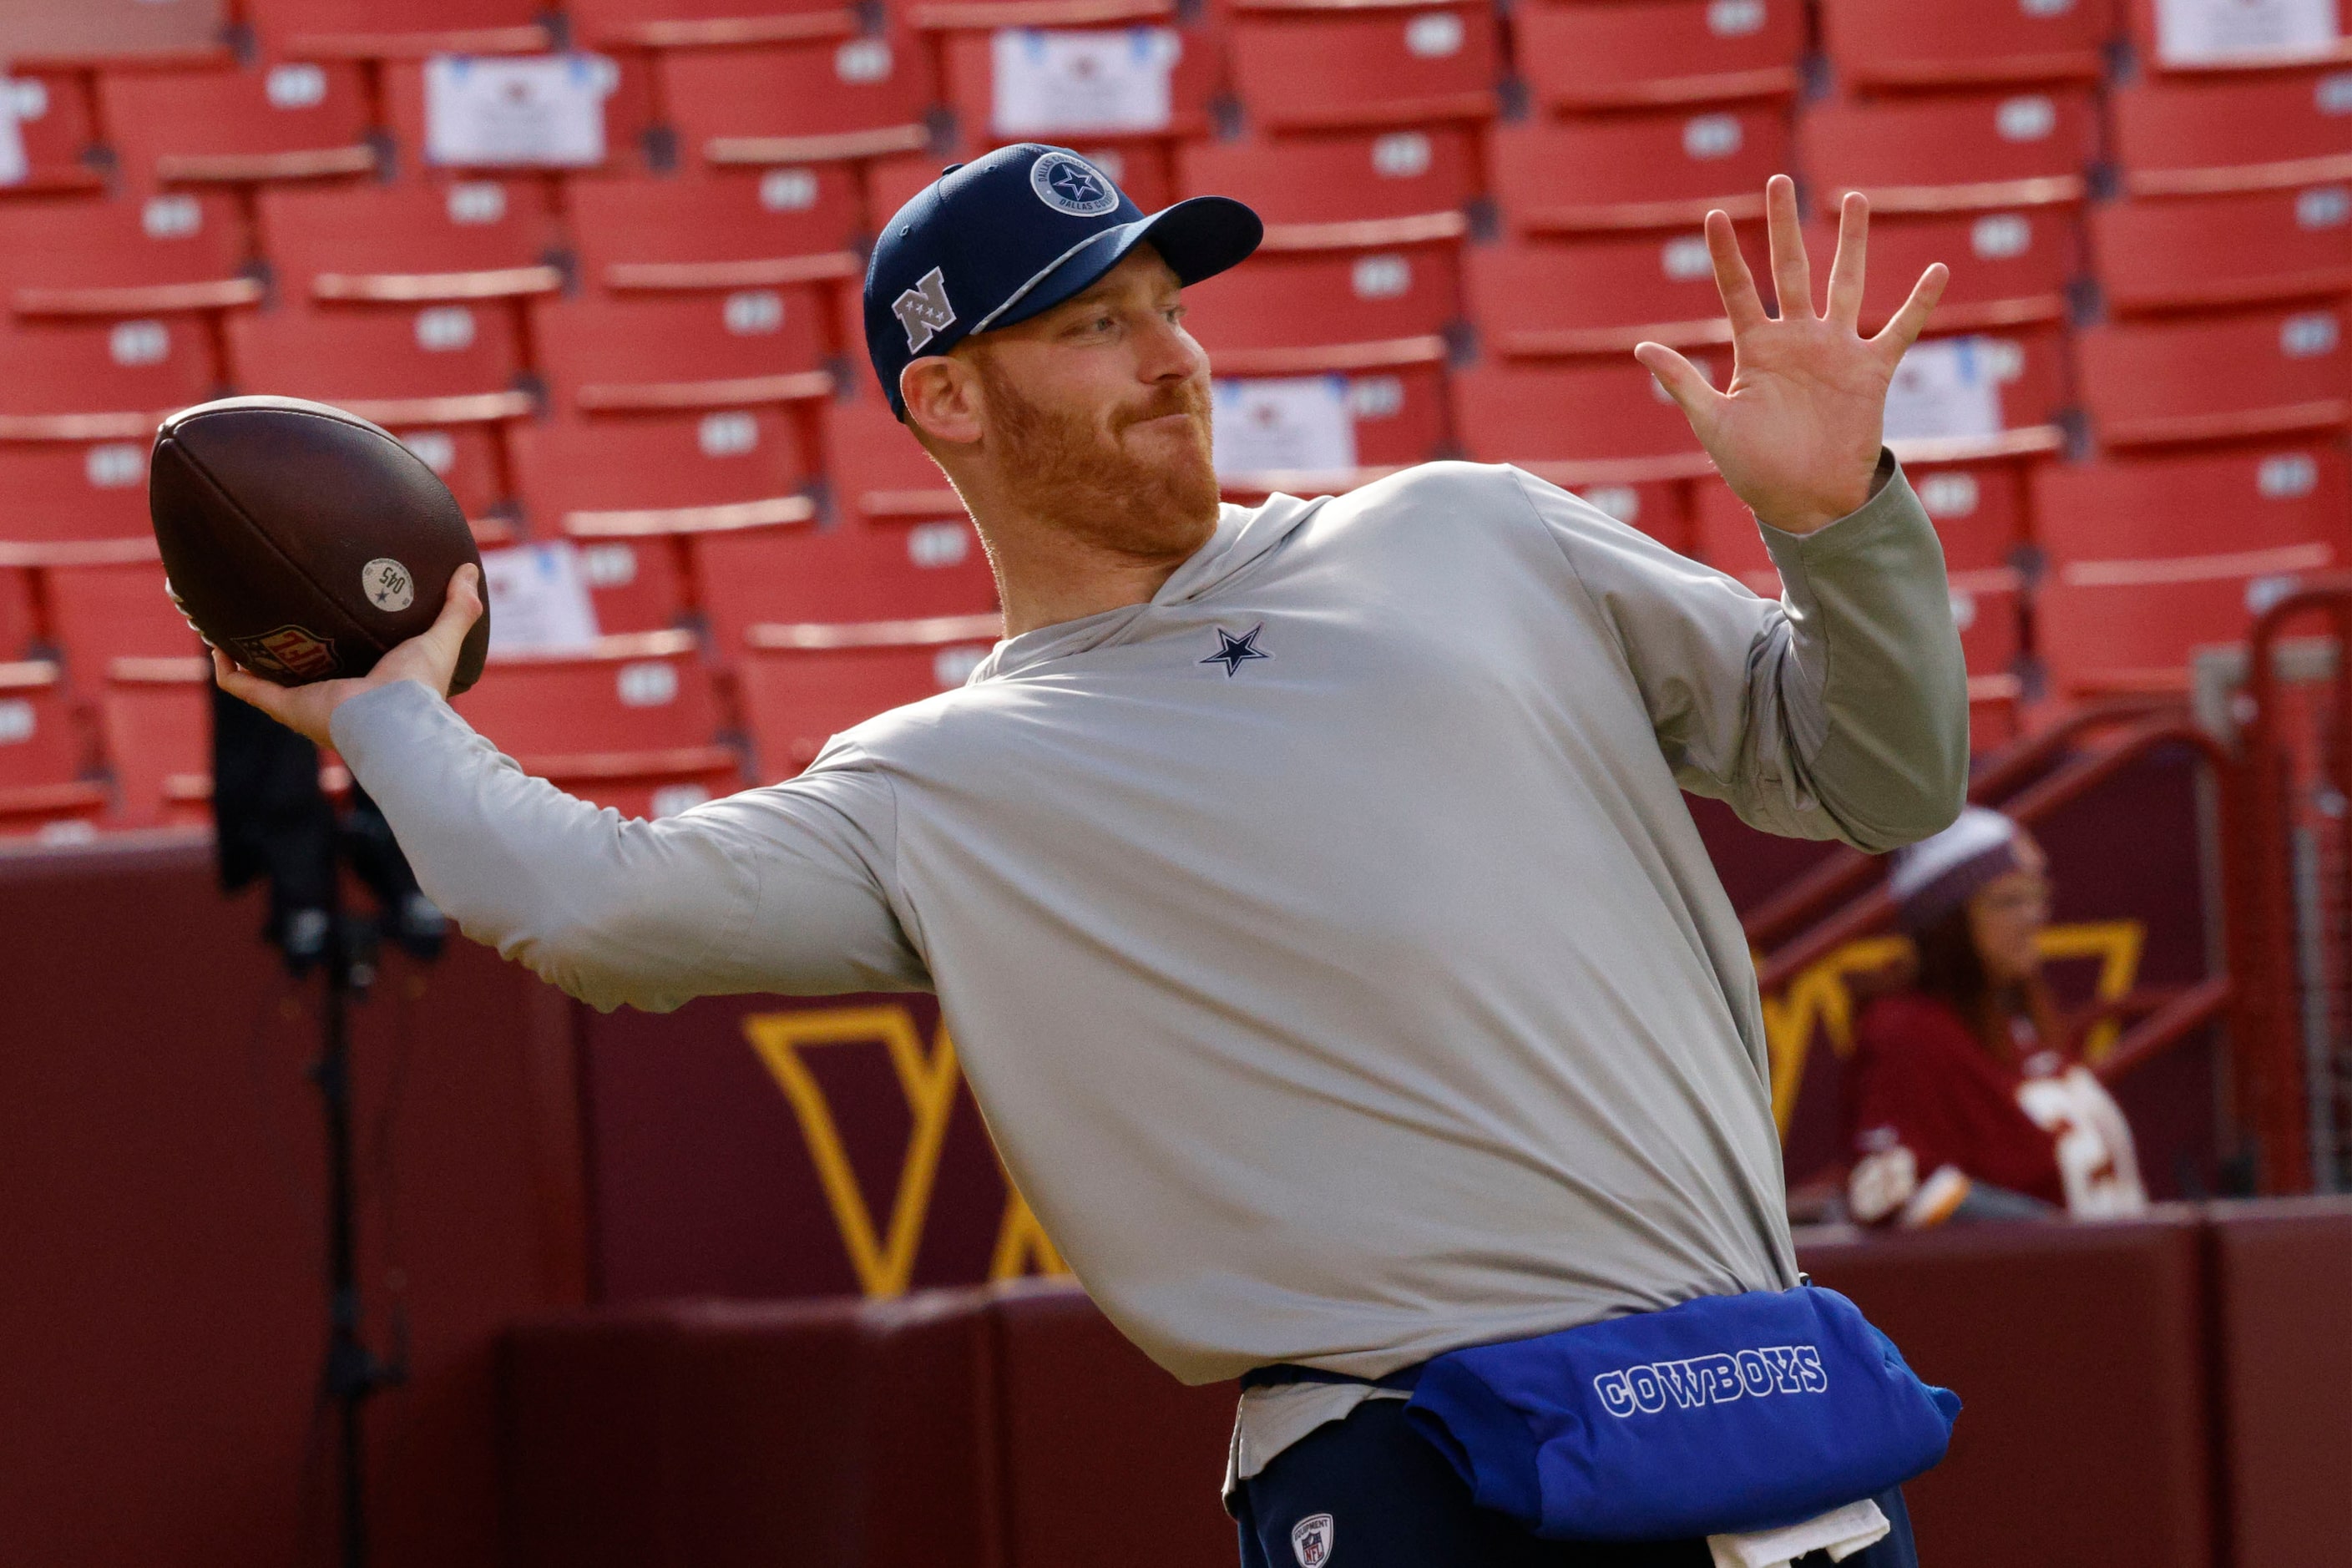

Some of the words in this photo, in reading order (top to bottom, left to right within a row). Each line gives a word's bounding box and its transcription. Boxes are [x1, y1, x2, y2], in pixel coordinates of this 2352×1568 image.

[1038, 159, 1055, 182] DALLAS
[1060, 199, 1094, 210] DALLAS
[891, 266, 958, 355] N
[379, 567, 405, 594] 045
[1594, 1346, 1828, 1418] COWBOYS
[1294, 1519, 1328, 1542] EQUIPMENT
[1305, 1544, 1323, 1563] NFL
